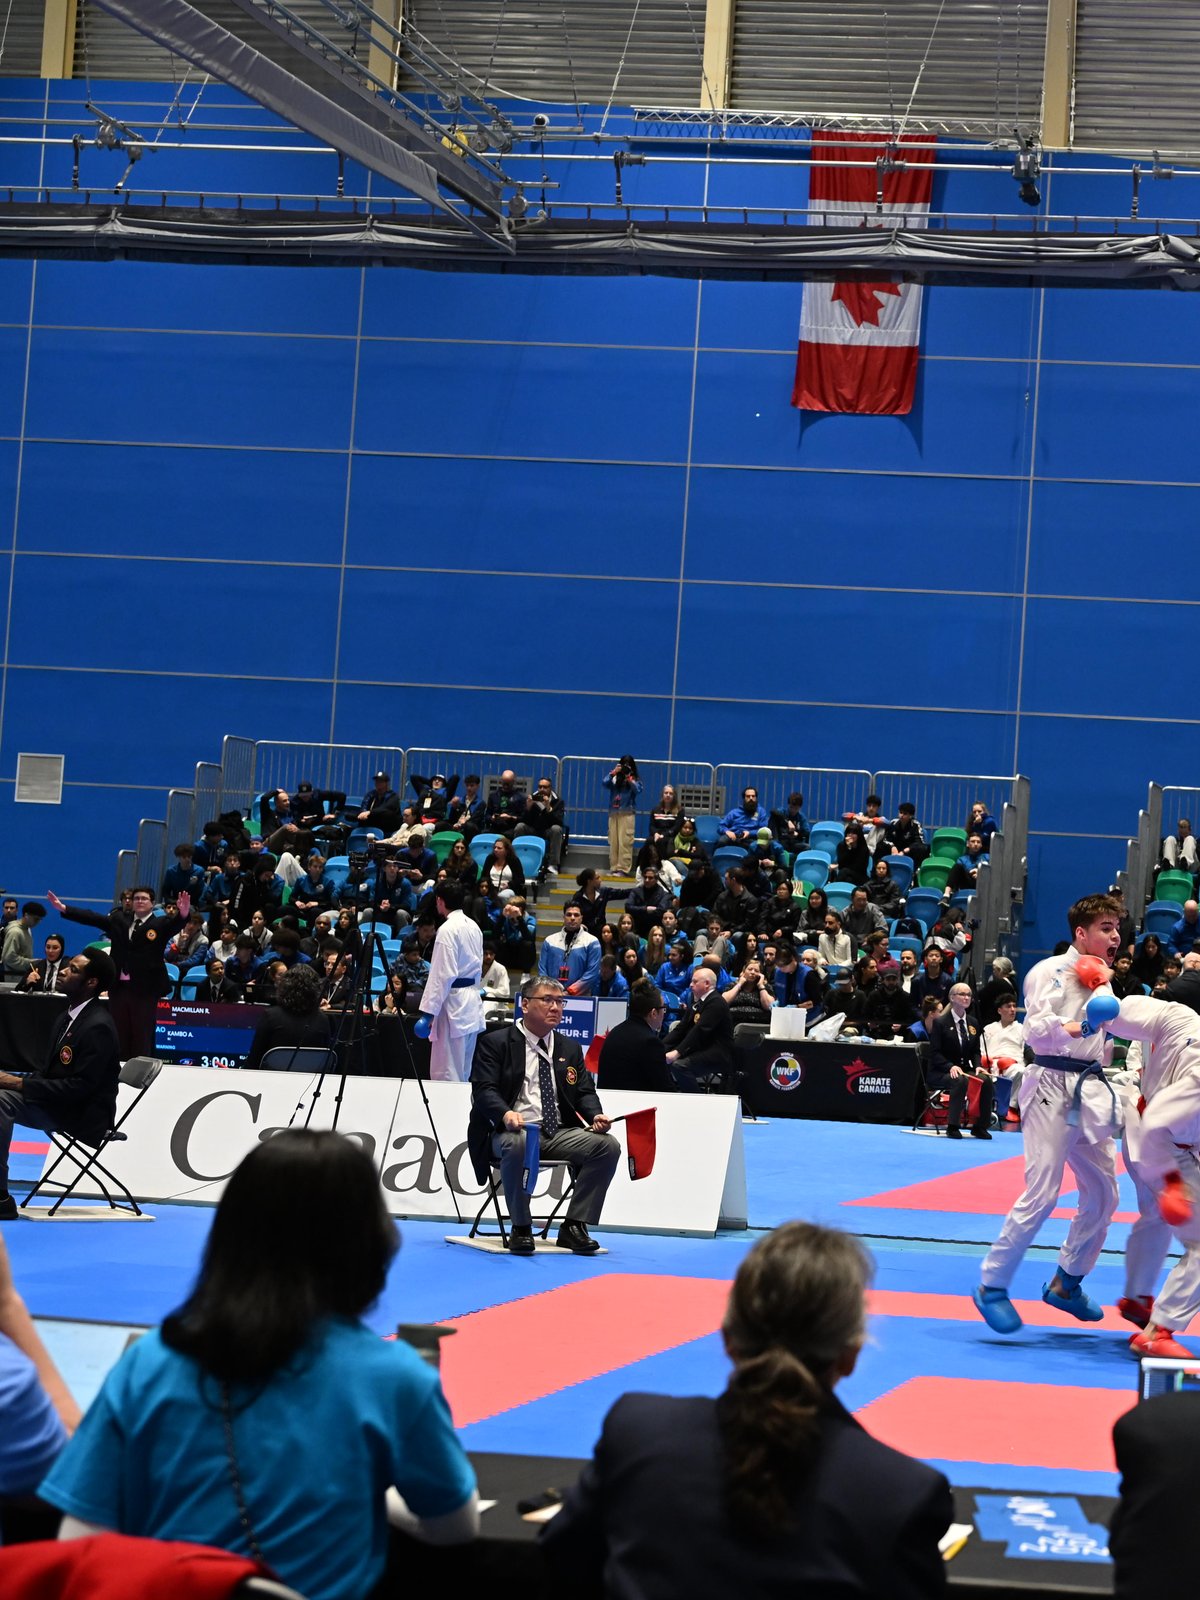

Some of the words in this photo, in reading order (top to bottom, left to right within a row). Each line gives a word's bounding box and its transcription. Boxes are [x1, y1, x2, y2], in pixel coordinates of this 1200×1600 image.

[172, 1006, 204, 1014] MACMILLAN
[776, 1066, 795, 1076] WKF
[859, 1076, 891, 1086] KARATE
[858, 1085, 891, 1094] CANADA
